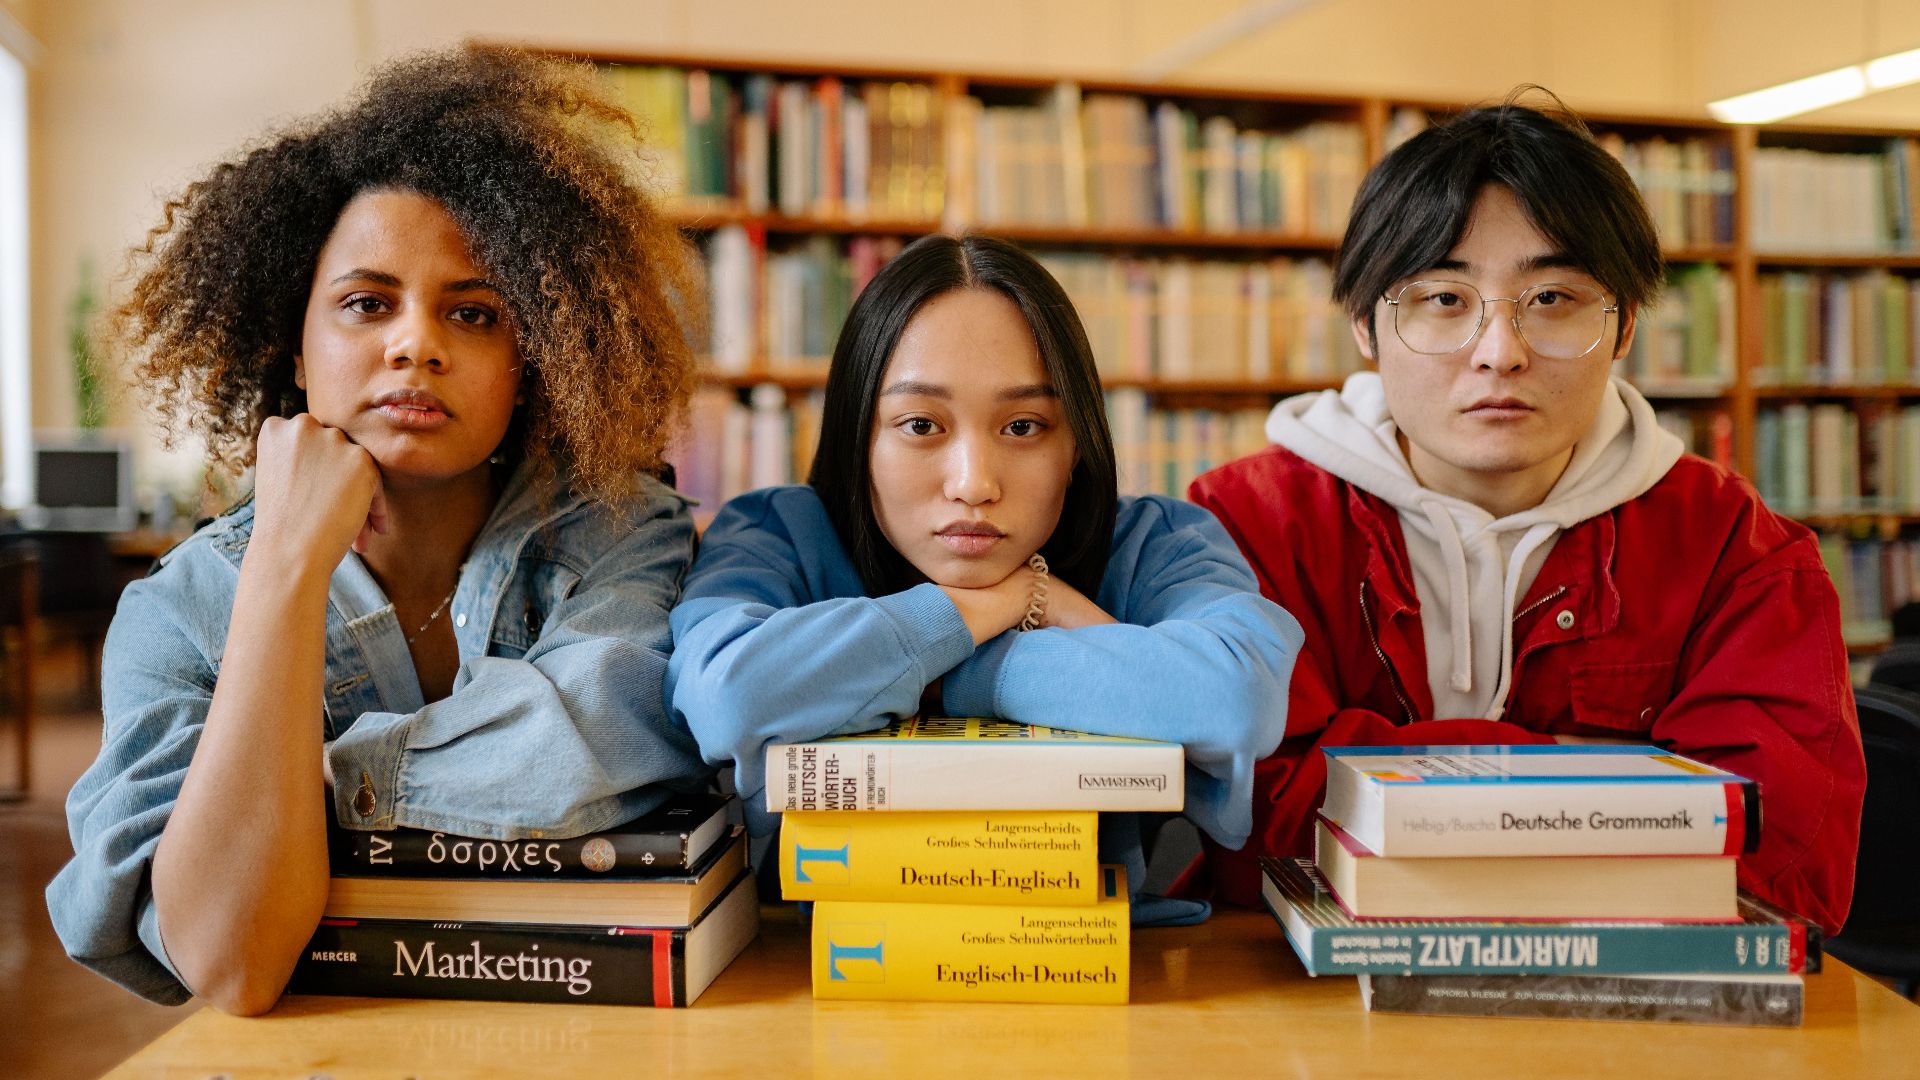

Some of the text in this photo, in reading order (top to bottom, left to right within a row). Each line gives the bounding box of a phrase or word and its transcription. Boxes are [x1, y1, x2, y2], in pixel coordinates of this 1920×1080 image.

[785, 747, 798, 811] Das neue große
[802, 747, 817, 811] DEUTSCHE
[821, 752, 839, 811] WÖRTER-
[842, 777, 857, 811] BUCH
[877, 787, 886, 805] BUCH
[984, 821, 1082, 836] Langenscheidts
[1500, 810, 1583, 832] Deutsche
[1588, 810, 1693, 831] Grammatik
[369, 835, 393, 865] IV
[926, 836, 1082, 852] Großes Schulwörterbuch
[900, 867, 1081, 894] Deutsch-Englisch
[1019, 916, 1118, 931] Langenscheidts
[961, 931, 1118, 946] Großes Schulwörterbuch
[312, 950, 357, 963] MERCER
[1418, 934, 1598, 968] MARKTPLATZ
[393, 940, 592, 996] Marketing
[936, 964, 1117, 988] Englisch-Deutsch
[1427, 987, 1469, 998] MEMORIA
[1514, 990, 1533, 1000] ZUM
[1595, 994, 1626, 1003] MARIAN
